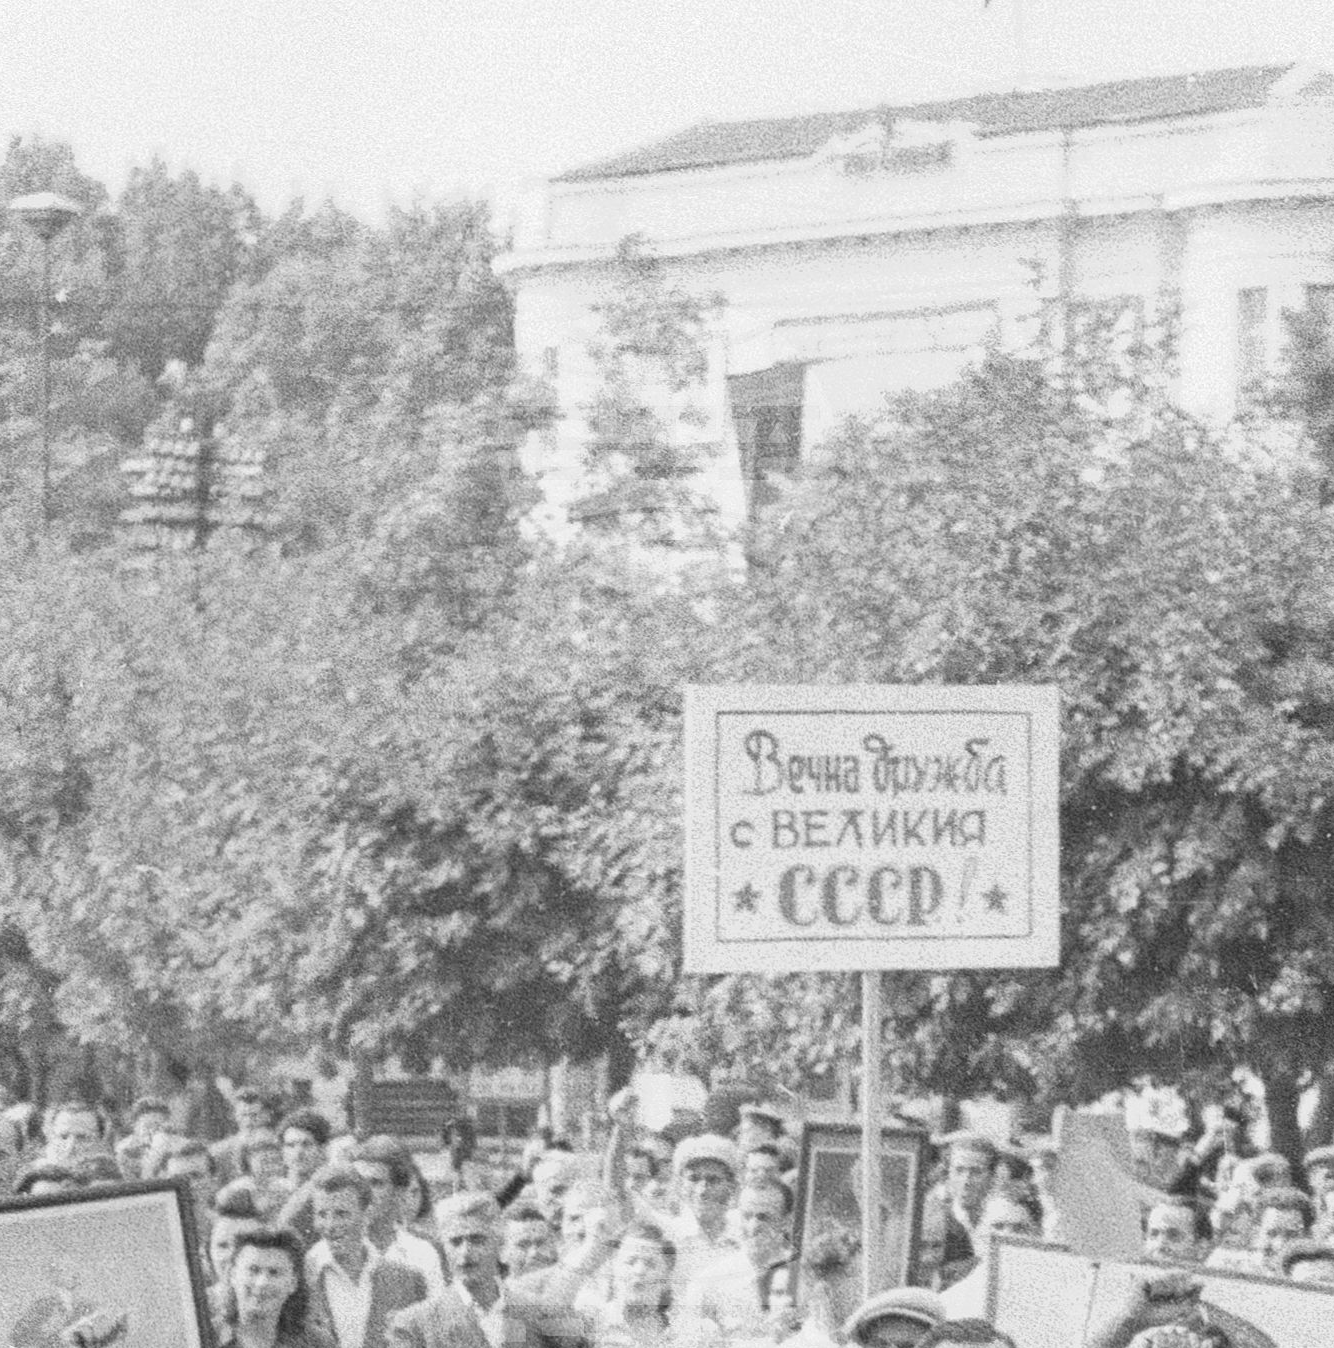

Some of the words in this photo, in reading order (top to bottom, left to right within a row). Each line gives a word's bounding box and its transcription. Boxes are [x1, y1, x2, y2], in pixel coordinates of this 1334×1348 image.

[743, 729, 861, 796] Вечна
[862, 733, 1008, 796] дружба
[770, 808, 987, 849] ВЕЛИКИЯ
